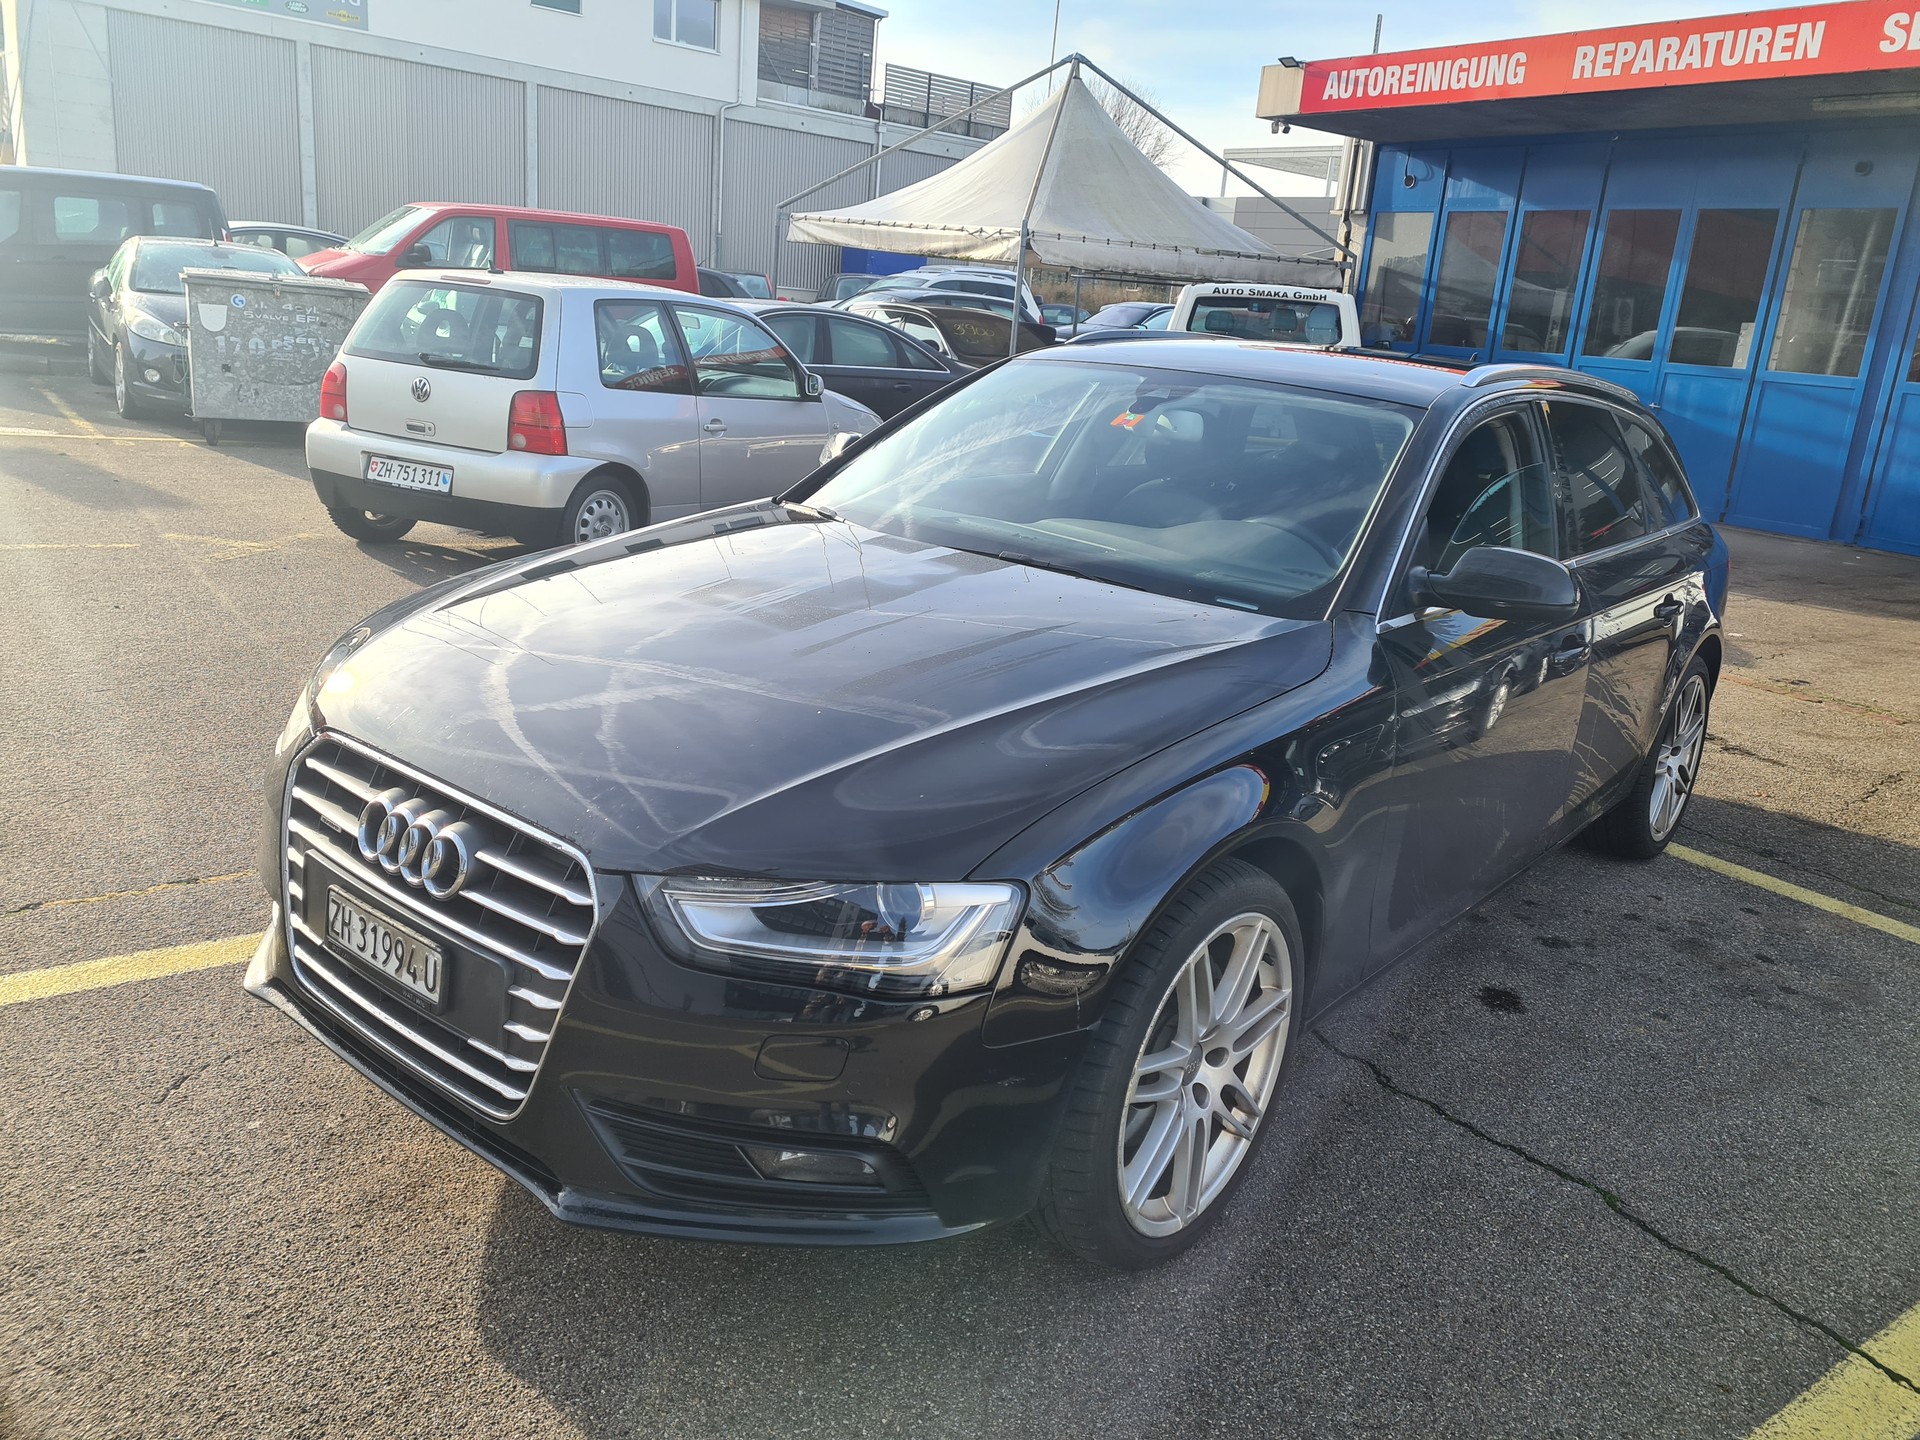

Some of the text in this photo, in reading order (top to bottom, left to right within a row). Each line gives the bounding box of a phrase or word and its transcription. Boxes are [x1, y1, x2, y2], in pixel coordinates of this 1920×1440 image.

[1322, 52, 1527, 100] AUTOREINIGUNG
[1572, 21, 1826, 79] REPARATUREN
[1293, 291, 1327, 301] GmbH
